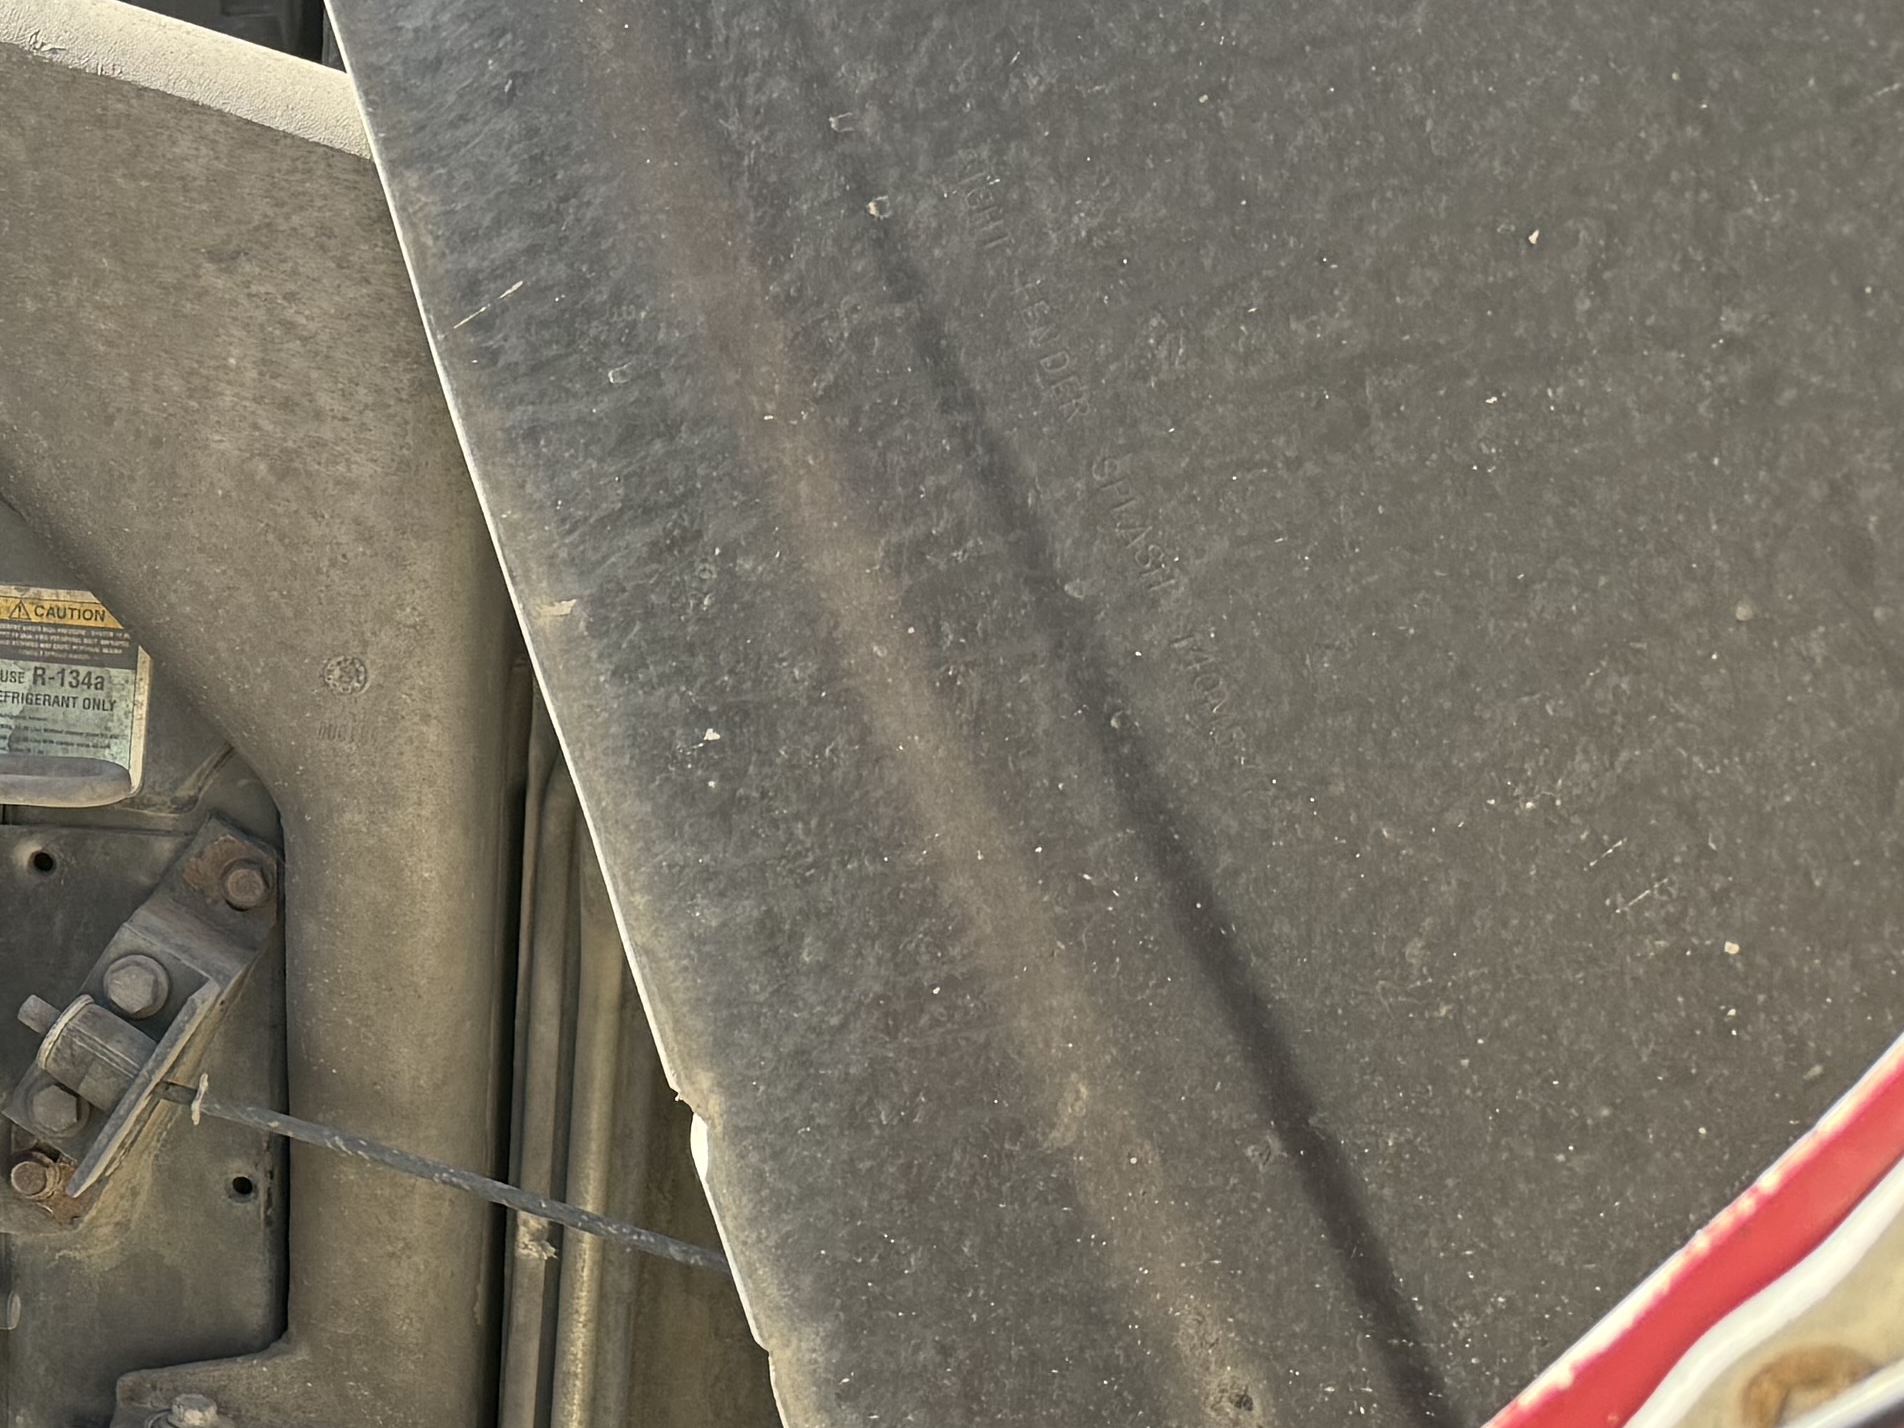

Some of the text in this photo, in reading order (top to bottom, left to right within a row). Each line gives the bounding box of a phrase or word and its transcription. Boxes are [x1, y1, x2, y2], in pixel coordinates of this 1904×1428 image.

[34, 604, 107, 623] CAUTION
[0, 665, 106, 692] USE R-134a
[82, 696, 117, 713] ONLY
